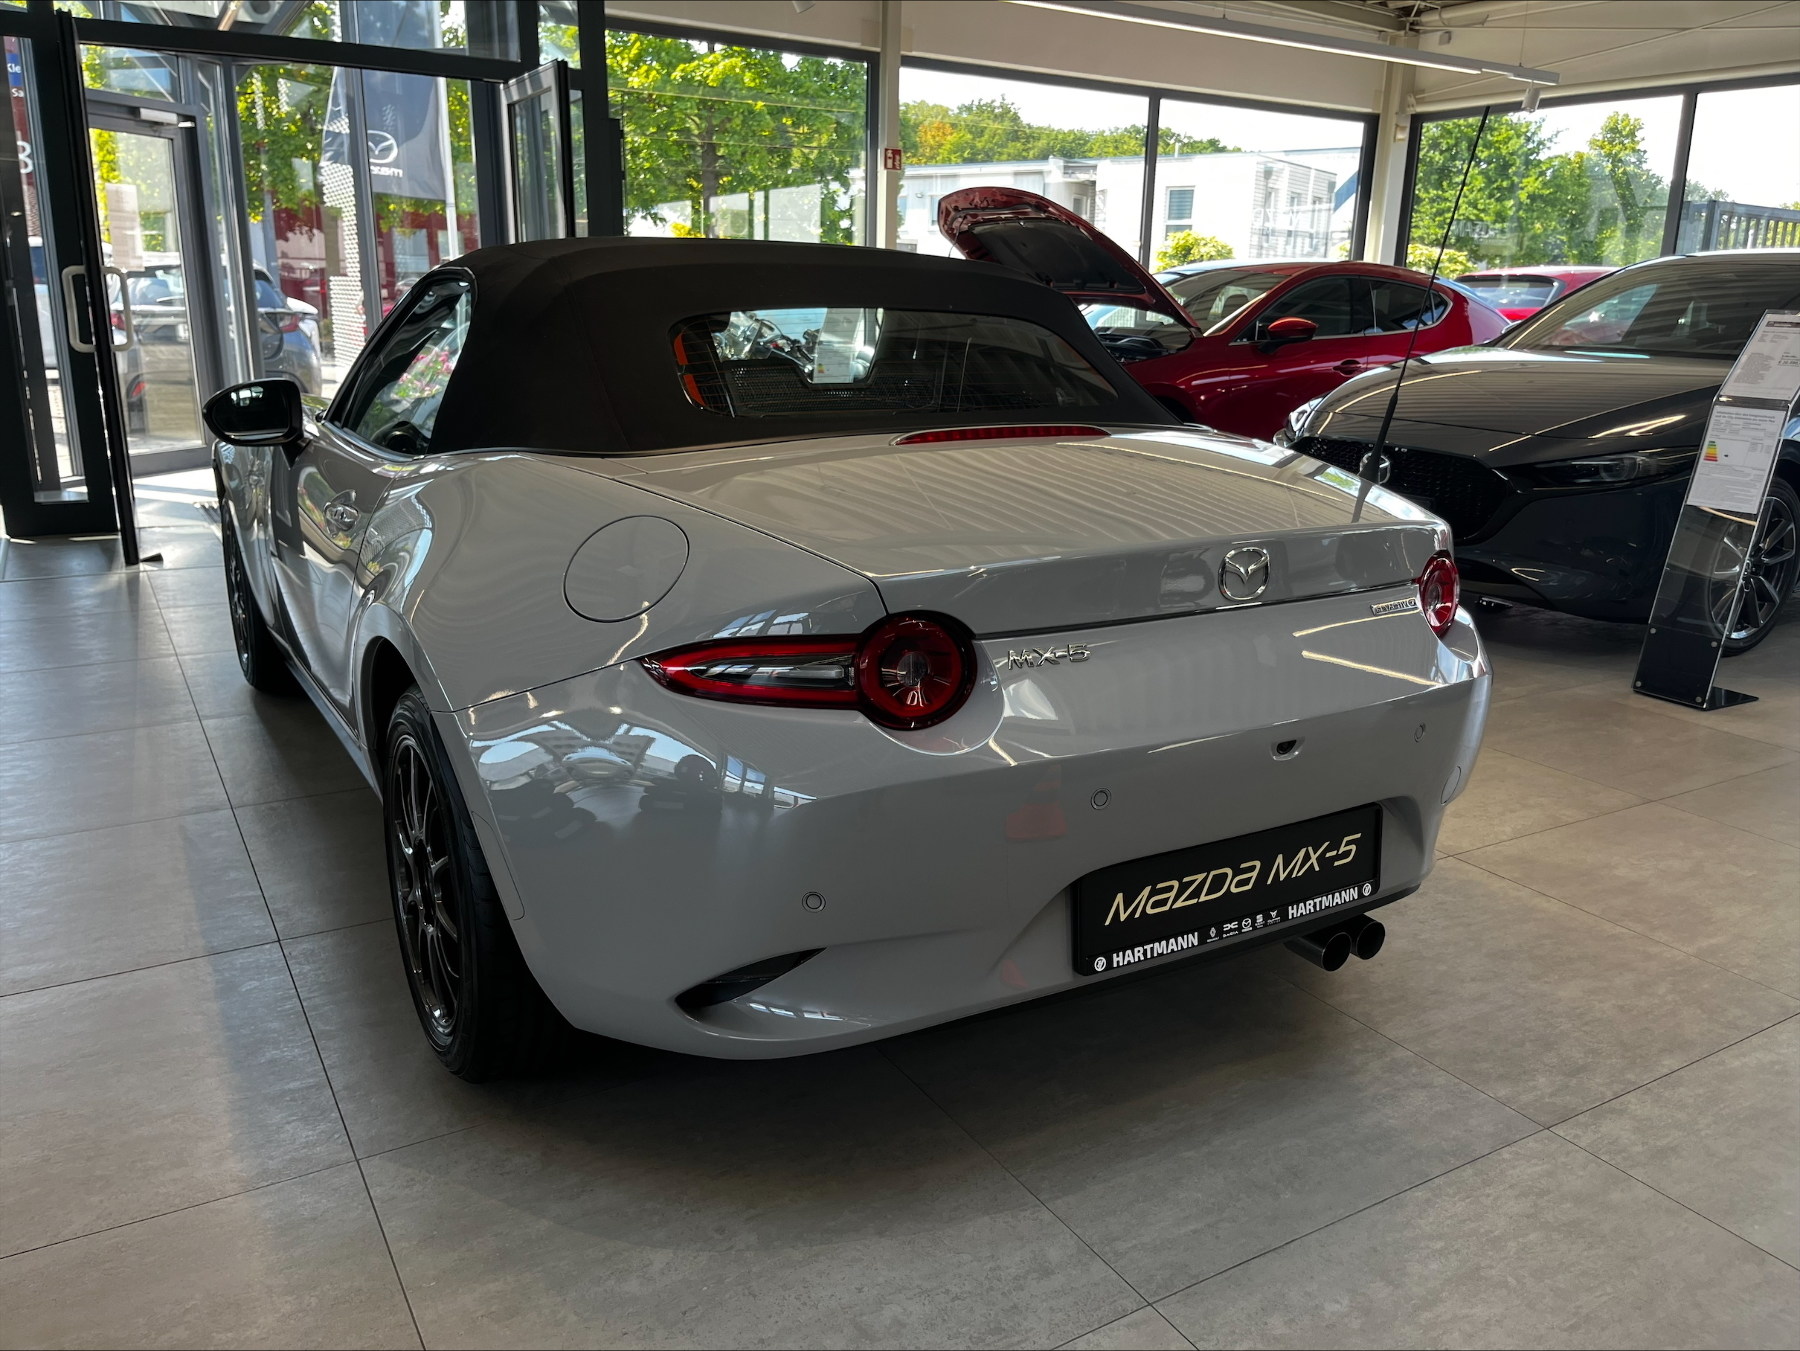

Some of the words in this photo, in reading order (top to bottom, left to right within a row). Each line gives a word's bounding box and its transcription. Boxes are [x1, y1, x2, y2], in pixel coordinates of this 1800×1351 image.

[1008, 643, 1090, 670] MX-5
[1266, 833, 1362, 885] MX-5
[1113, 932, 1199, 968] HARTMANN
[1288, 887, 1359, 920] HARTMANN
